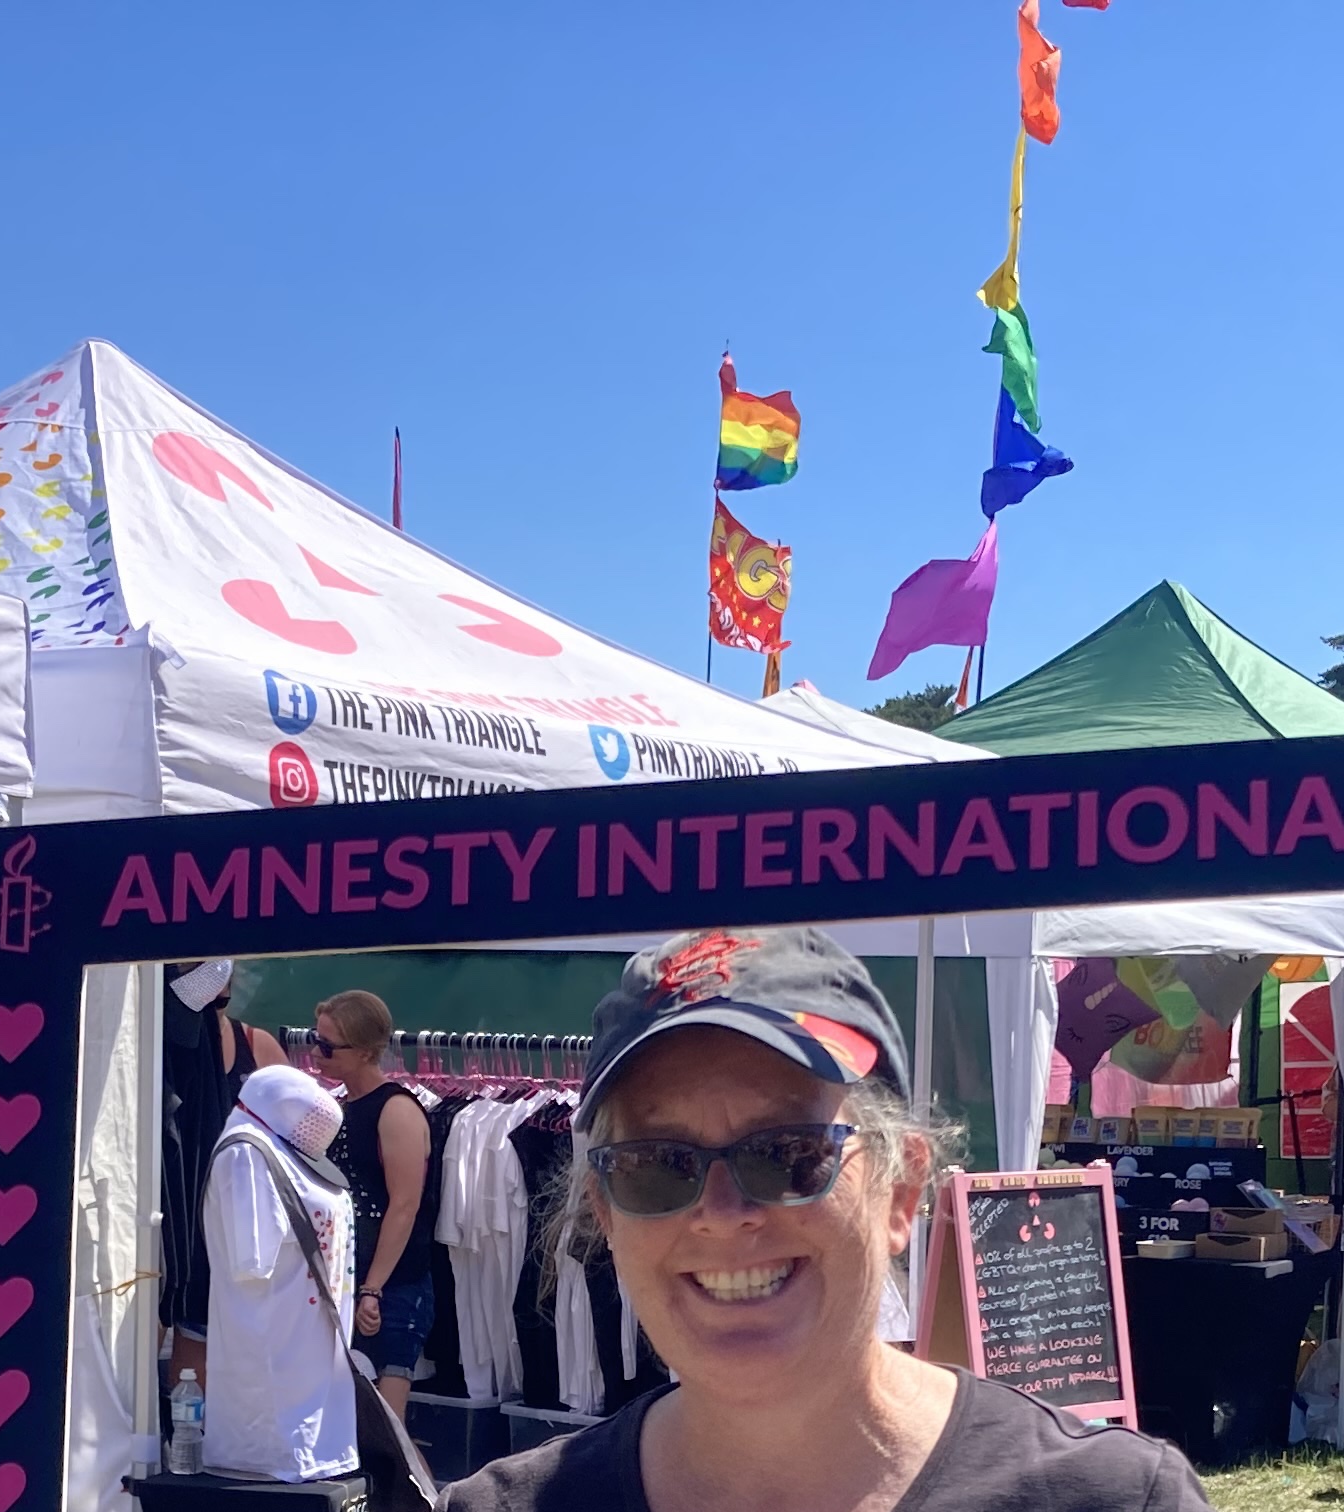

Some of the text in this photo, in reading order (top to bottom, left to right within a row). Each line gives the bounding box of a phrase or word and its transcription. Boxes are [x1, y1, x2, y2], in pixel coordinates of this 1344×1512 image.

[319, 686, 546, 757] THE PINK TRIANGLE
[101, 827, 556, 928] AMNESTY
[1107, 1145, 1154, 1156] LAVENDER
[1174, 1178, 1202, 1190] ROSE
[1138, 1216, 1180, 1231] 3 FOR
[1085, 1236, 1096, 1251] 2
[986, 1333, 1104, 1360] WE HAVE A LOOKING
[986, 1361, 1022, 1377] FIERCE
